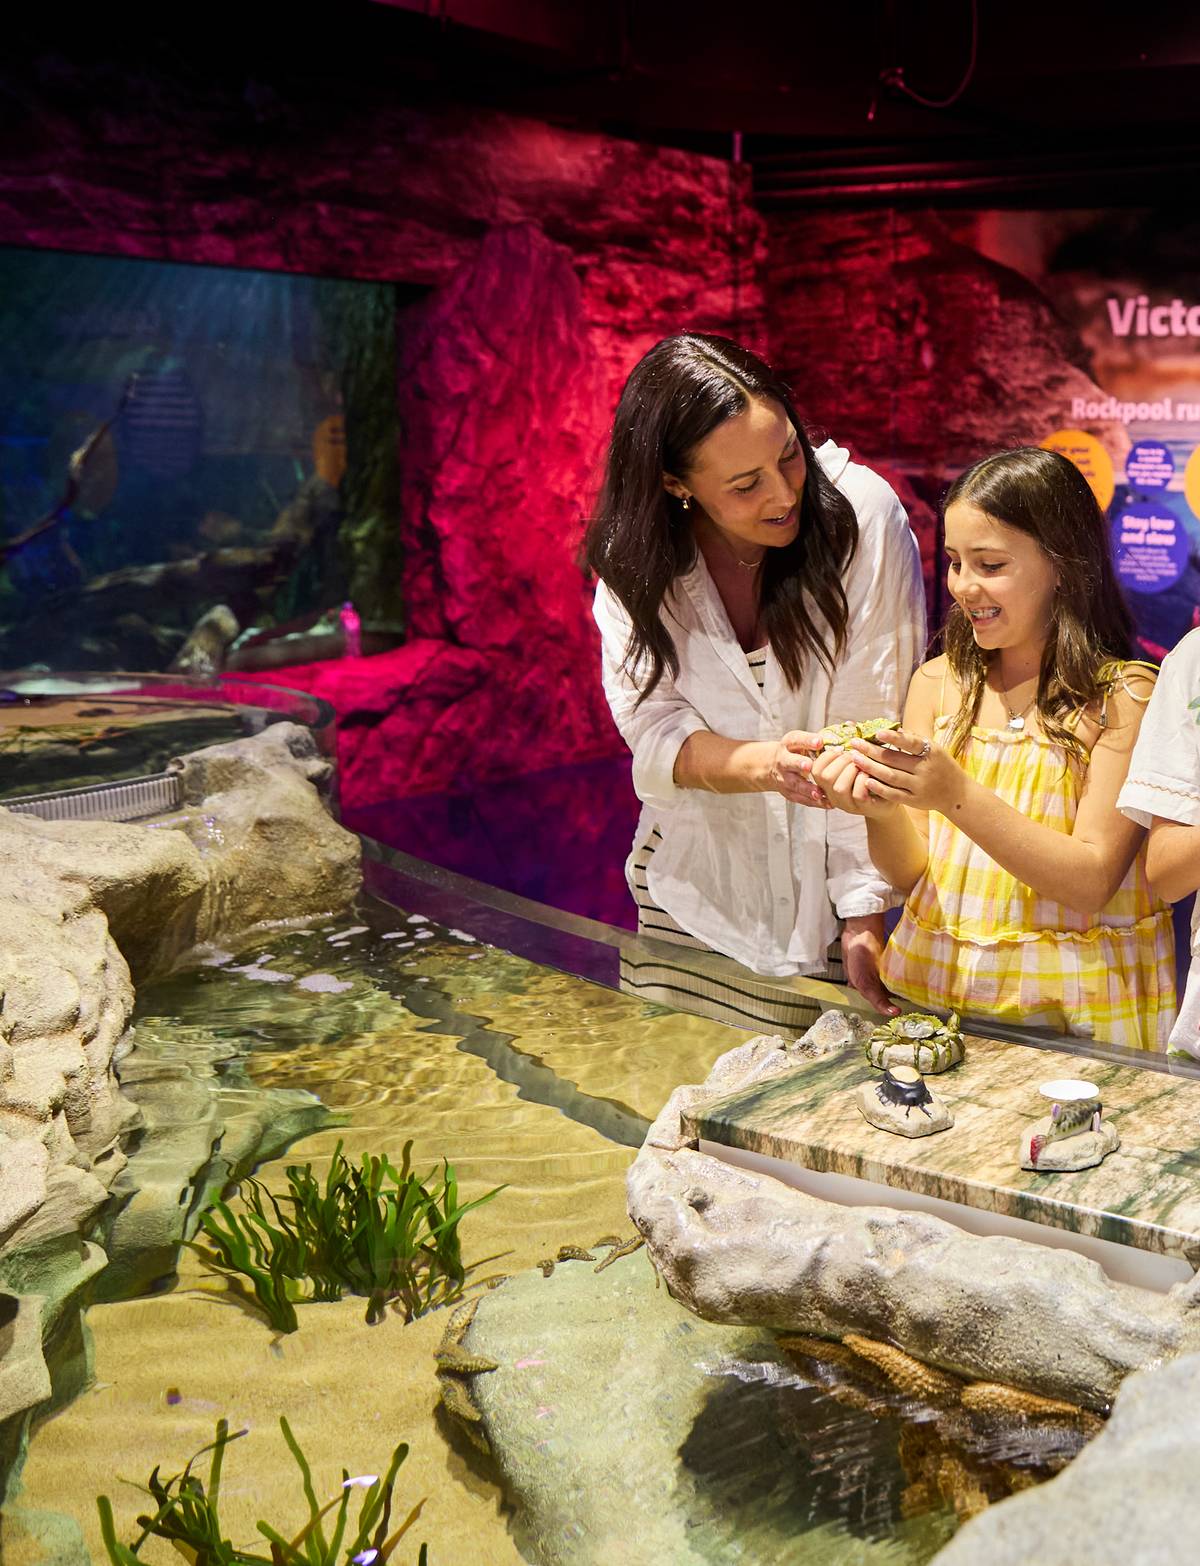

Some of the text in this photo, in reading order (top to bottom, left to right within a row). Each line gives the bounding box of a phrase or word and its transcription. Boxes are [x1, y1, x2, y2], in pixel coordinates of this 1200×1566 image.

[1071, 397, 1173, 424] Rockpool
[1122, 515, 1175, 532] Stay low
[1121, 530, 1177, 546] and slow
